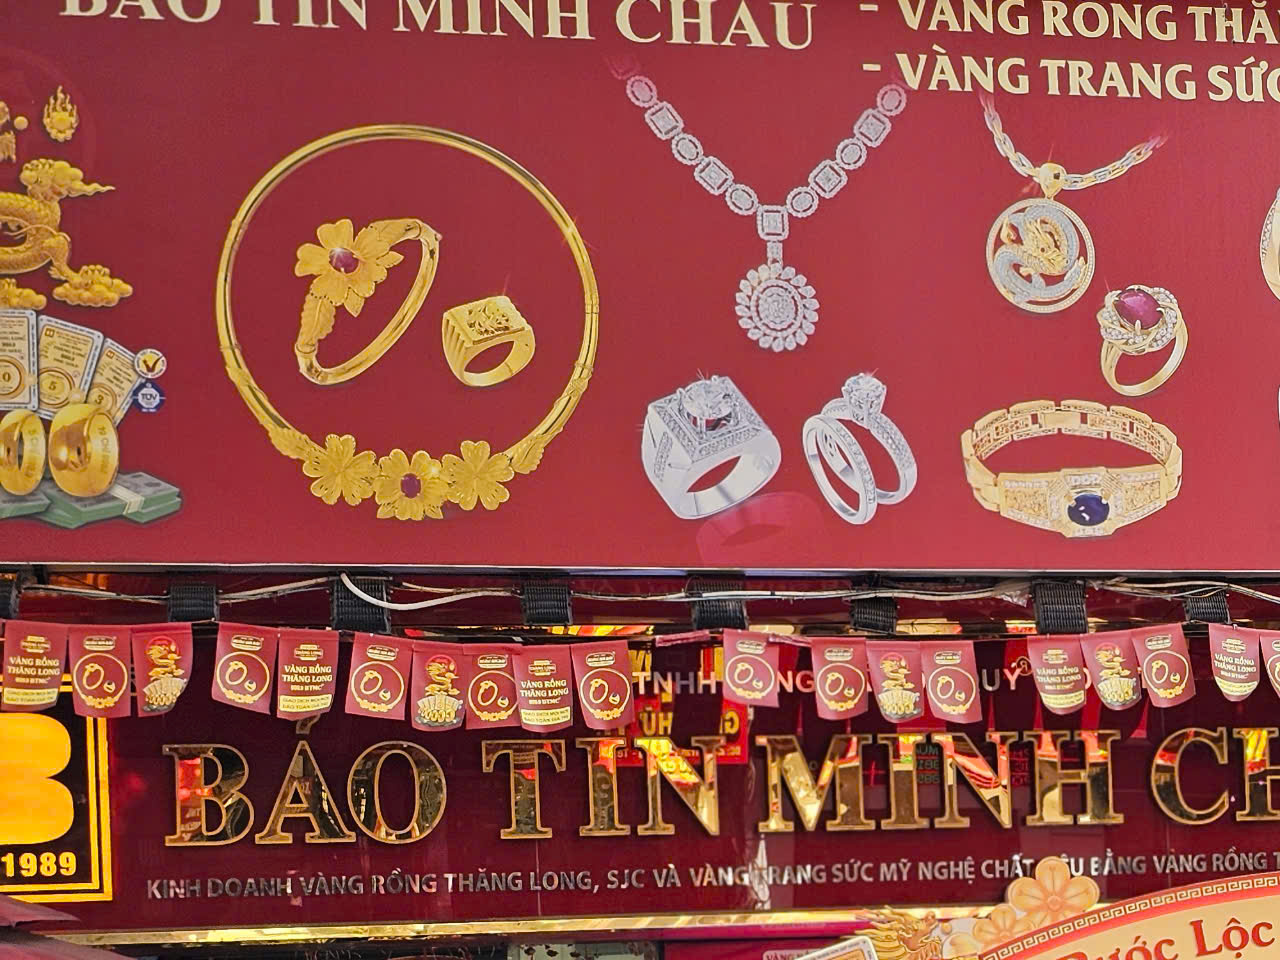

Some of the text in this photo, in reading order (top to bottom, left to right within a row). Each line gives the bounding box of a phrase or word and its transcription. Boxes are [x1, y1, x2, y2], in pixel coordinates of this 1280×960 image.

[896, 43, 1030, 94] VÀNG
[1040, 58, 1197, 101] TRANG
[632, 671, 717, 694] TNHH
[777, 671, 815, 693] NG
[162, 716, 447, 847] BẢO
[756, 729, 1125, 834] MINH
[1, 851, 77, 877] 1989
[147, 878, 201, 900] KINH
[207, 877, 292, 898] DOANH
[299, 872, 364, 897] VÀNG
[371, 867, 437, 894] RỒNG
[443, 867, 523, 893] THĂNG
[529, 869, 600, 894] LONG,
[606, 868, 646, 890] SJC
[652, 863, 682, 889] VÀ
[689, 862, 748, 887] VÀNG
[832, 857, 874, 884] SỨC
[879, 856, 912, 882] MỸ
[918, 856, 976, 884] NGHỆ
[981, 852, 1035, 879] CHẤT
[1090, 848, 1146, 876] BẰNG
[1153, 849, 1207, 873] VÀNG
[1212, 846, 1268, 871] RỒNG
[1190, 917, 1276, 959] Lộc
